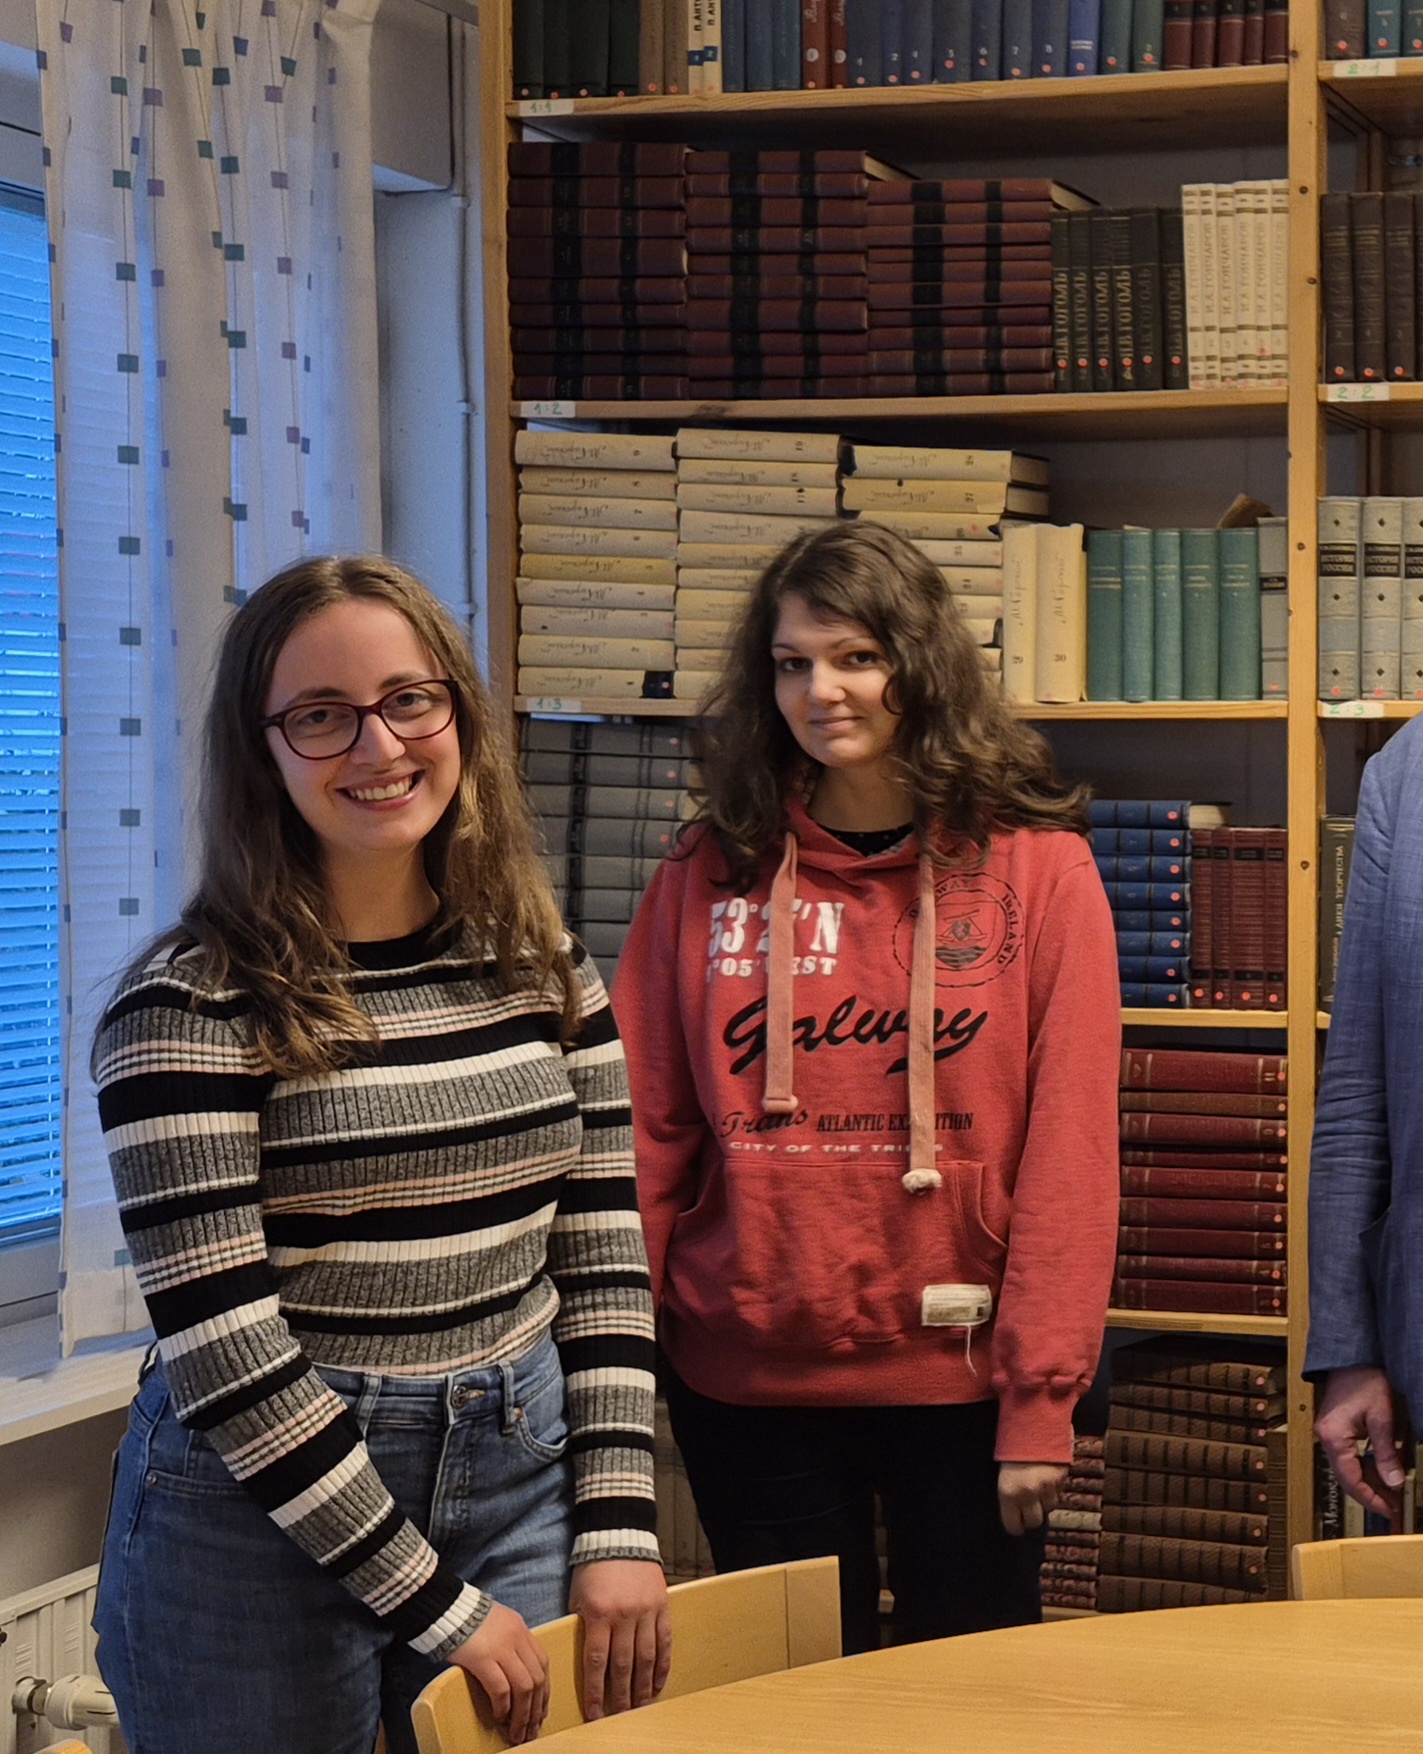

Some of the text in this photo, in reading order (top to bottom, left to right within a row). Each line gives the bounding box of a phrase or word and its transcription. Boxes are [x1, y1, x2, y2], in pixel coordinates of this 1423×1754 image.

[1336, 385, 1375, 400] 2:2
[533, 403, 563, 416] 1:2
[1330, 705, 1364, 715] 2:3
[998, 893, 1018, 964] IRELAND
[721, 1108, 973, 1138] Trans ATLANTIC EXITION
[728, 1141, 943, 1153] CITY OF THE TRIS
